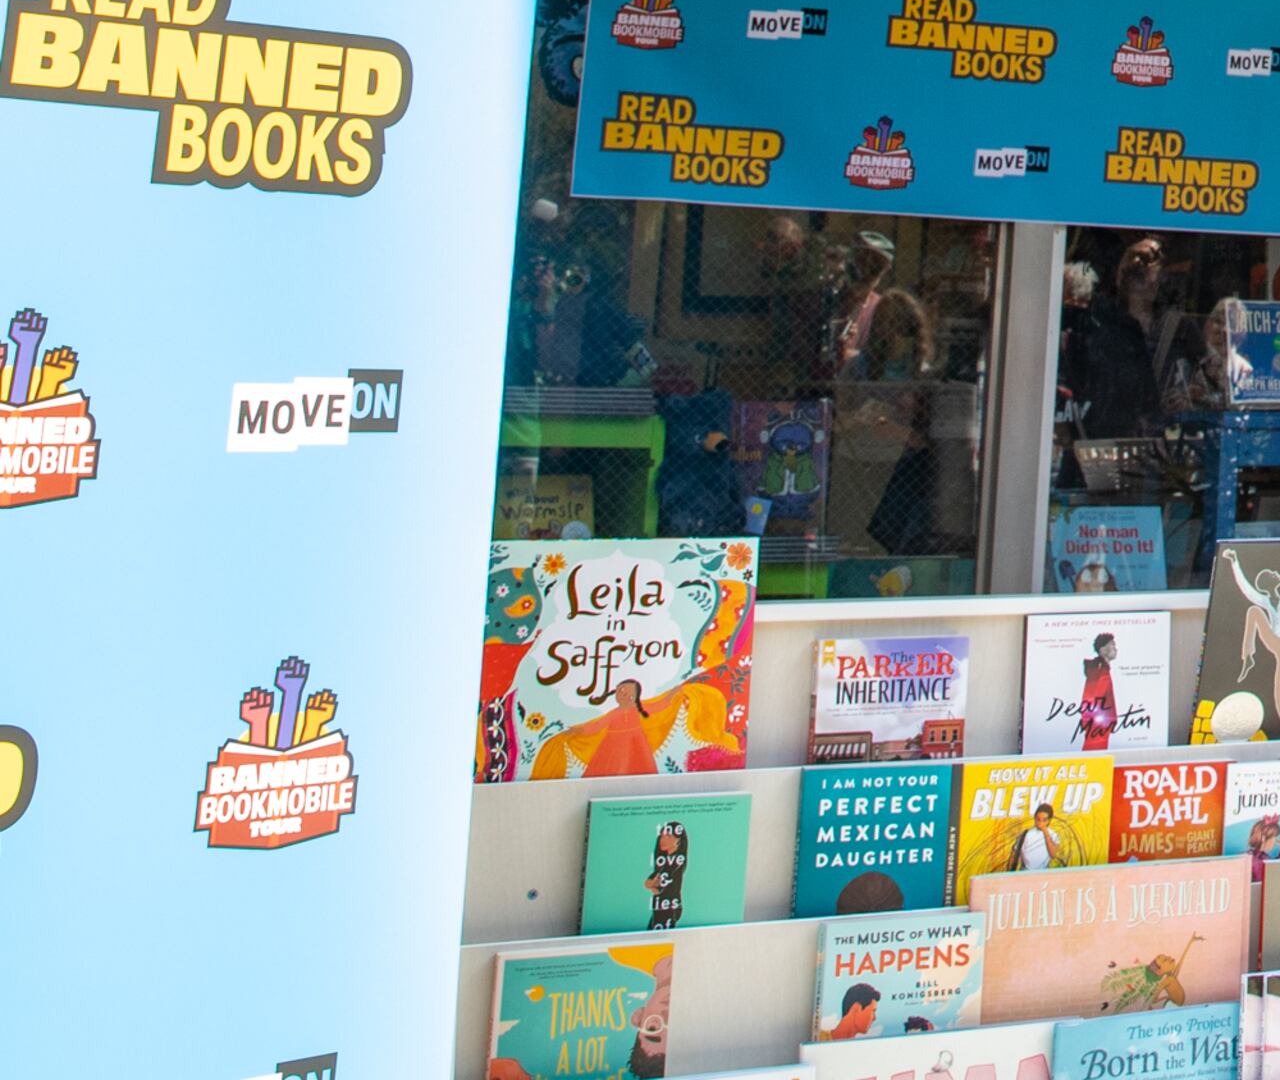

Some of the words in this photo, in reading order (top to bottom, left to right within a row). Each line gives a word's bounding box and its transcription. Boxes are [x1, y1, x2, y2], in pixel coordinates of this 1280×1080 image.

[889, 19, 1056, 56] BANNED
[11, 13, 401, 116] BANNED
[954, 51, 1042, 81] BOOKS
[620, 95, 693, 124] READ
[166, 104, 373, 185] BOOKS
[603, 122, 782, 158] BANNED
[1120, 129, 1182, 157] READ
[673, 156, 767, 185] BOOKS
[1107, 155, 1257, 188] BANNED
[1164, 186, 1246, 214] BOOKS
[1079, 525, 1138, 538] Norman
[1113, 541, 1133, 553] Do
[1137, 540, 1154, 552] It!
[567, 564, 665, 620] Leila
[607, 614, 625, 630] in
[536, 634, 682, 705] Saffron
[837, 652, 954, 679] PARKER
[891, 652, 916, 663] The
[836, 677, 950, 704] INHERITANCE
[1046, 697, 1111, 721] Dear
[1071, 704, 1150, 744] Martin
[209, 755, 350, 794] BANNED
[822, 779, 826, 789] I
[833, 779, 855, 789] AM
[862, 777, 892, 787] NOT
[899, 775, 938, 786] YOUR
[989, 768, 1031, 784] HOW
[1034, 766, 1053, 780] IT
[1056, 765, 1088, 779] ALL
[1124, 766, 1217, 798] ROALD
[200, 782, 353, 825] BOOKMOBILE
[819, 795, 938, 816] PERFECT
[971, 785, 1057, 820] BLEW
[1062, 783, 1104, 812] UP
[1129, 796, 1208, 828] DAHL
[1234, 790, 1278, 815] junie
[250, 817, 302, 838] TOUR
[656, 822, 684, 835] the
[817, 822, 935, 843] MEXICAN
[1187, 829, 1215, 840] GIANT
[816, 848, 933, 867] DAUGHTER
[1118, 833, 1174, 856] JAMES
[1187, 840, 1216, 854] PEACH
[650, 852, 685, 866] love
[660, 872, 673, 887] &
[650, 896, 679, 910] lies
[986, 882, 1066, 940] JULIÁN
[1075, 888, 1096, 925] IS
[1105, 886, 1118, 922] A
[1126, 878, 1230, 928] MERMAID
[835, 936, 855, 944] THE
[857, 931, 905, 945] MUSIC
[928, 925, 971, 938] WHAT
[835, 944, 969, 976] HAPPENS
[892, 988, 961, 1000] KONIGSBERG
[549, 987, 628, 1039] THANKS
[1128, 1026, 1153, 1040] The
[1158, 1024, 1182, 1036] 1619
[1186, 1015, 1232, 1032] Project
[556, 1041, 569, 1075] A
[576, 1036, 610, 1074] LOT.
[1169, 1041, 1183, 1052] on
[1190, 1034, 1239, 1065] Wat
[1081, 1049, 1159, 1080] Born
[1166, 1057, 1186, 1070] the
